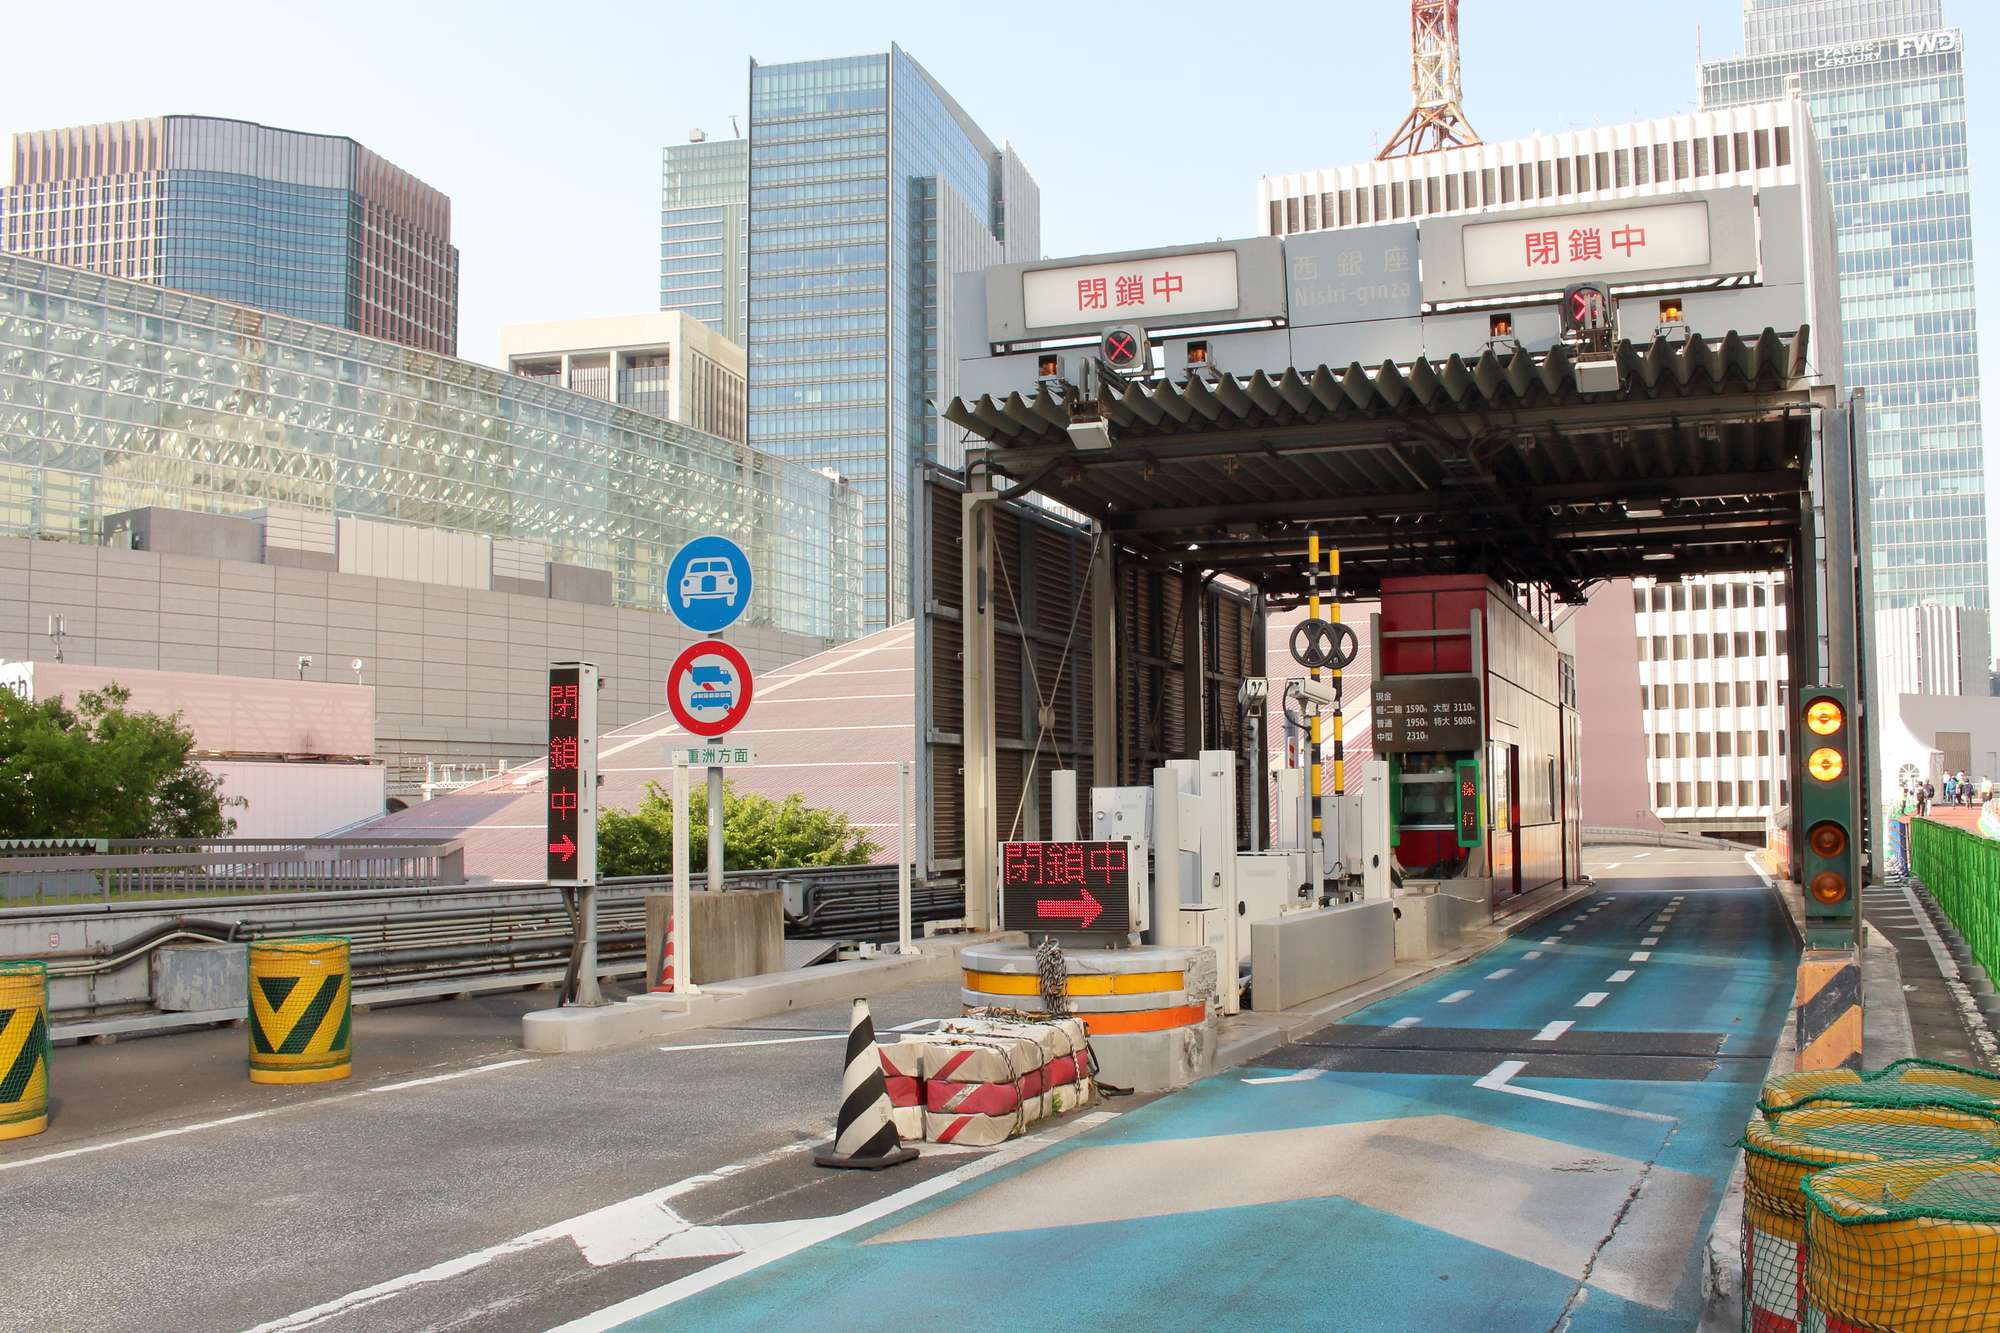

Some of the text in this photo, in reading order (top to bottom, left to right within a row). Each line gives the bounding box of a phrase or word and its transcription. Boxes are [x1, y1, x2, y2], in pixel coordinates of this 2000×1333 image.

[1897, 31, 1956, 58] FWD
[1814, 52, 1882, 69] CENTURY
[1524, 223, 1647, 268] 閉鎖中
[1293, 245, 1411, 280] 西銀座
[1076, 271, 1184, 312] 閉鎖中
[1294, 281, 1411, 307] Nishi-ginza
[1376, 692, 1392, 701] 現金
[1432, 703, 1450, 712] 大型
[1434, 717, 1450, 726] 特大
[1376, 732, 1392, 741] 中型
[549, 684, 579, 821] 閉鎖中
[1461, 781, 1476, 826] 徐行
[1005, 841, 1127, 886] 閉鎖中
